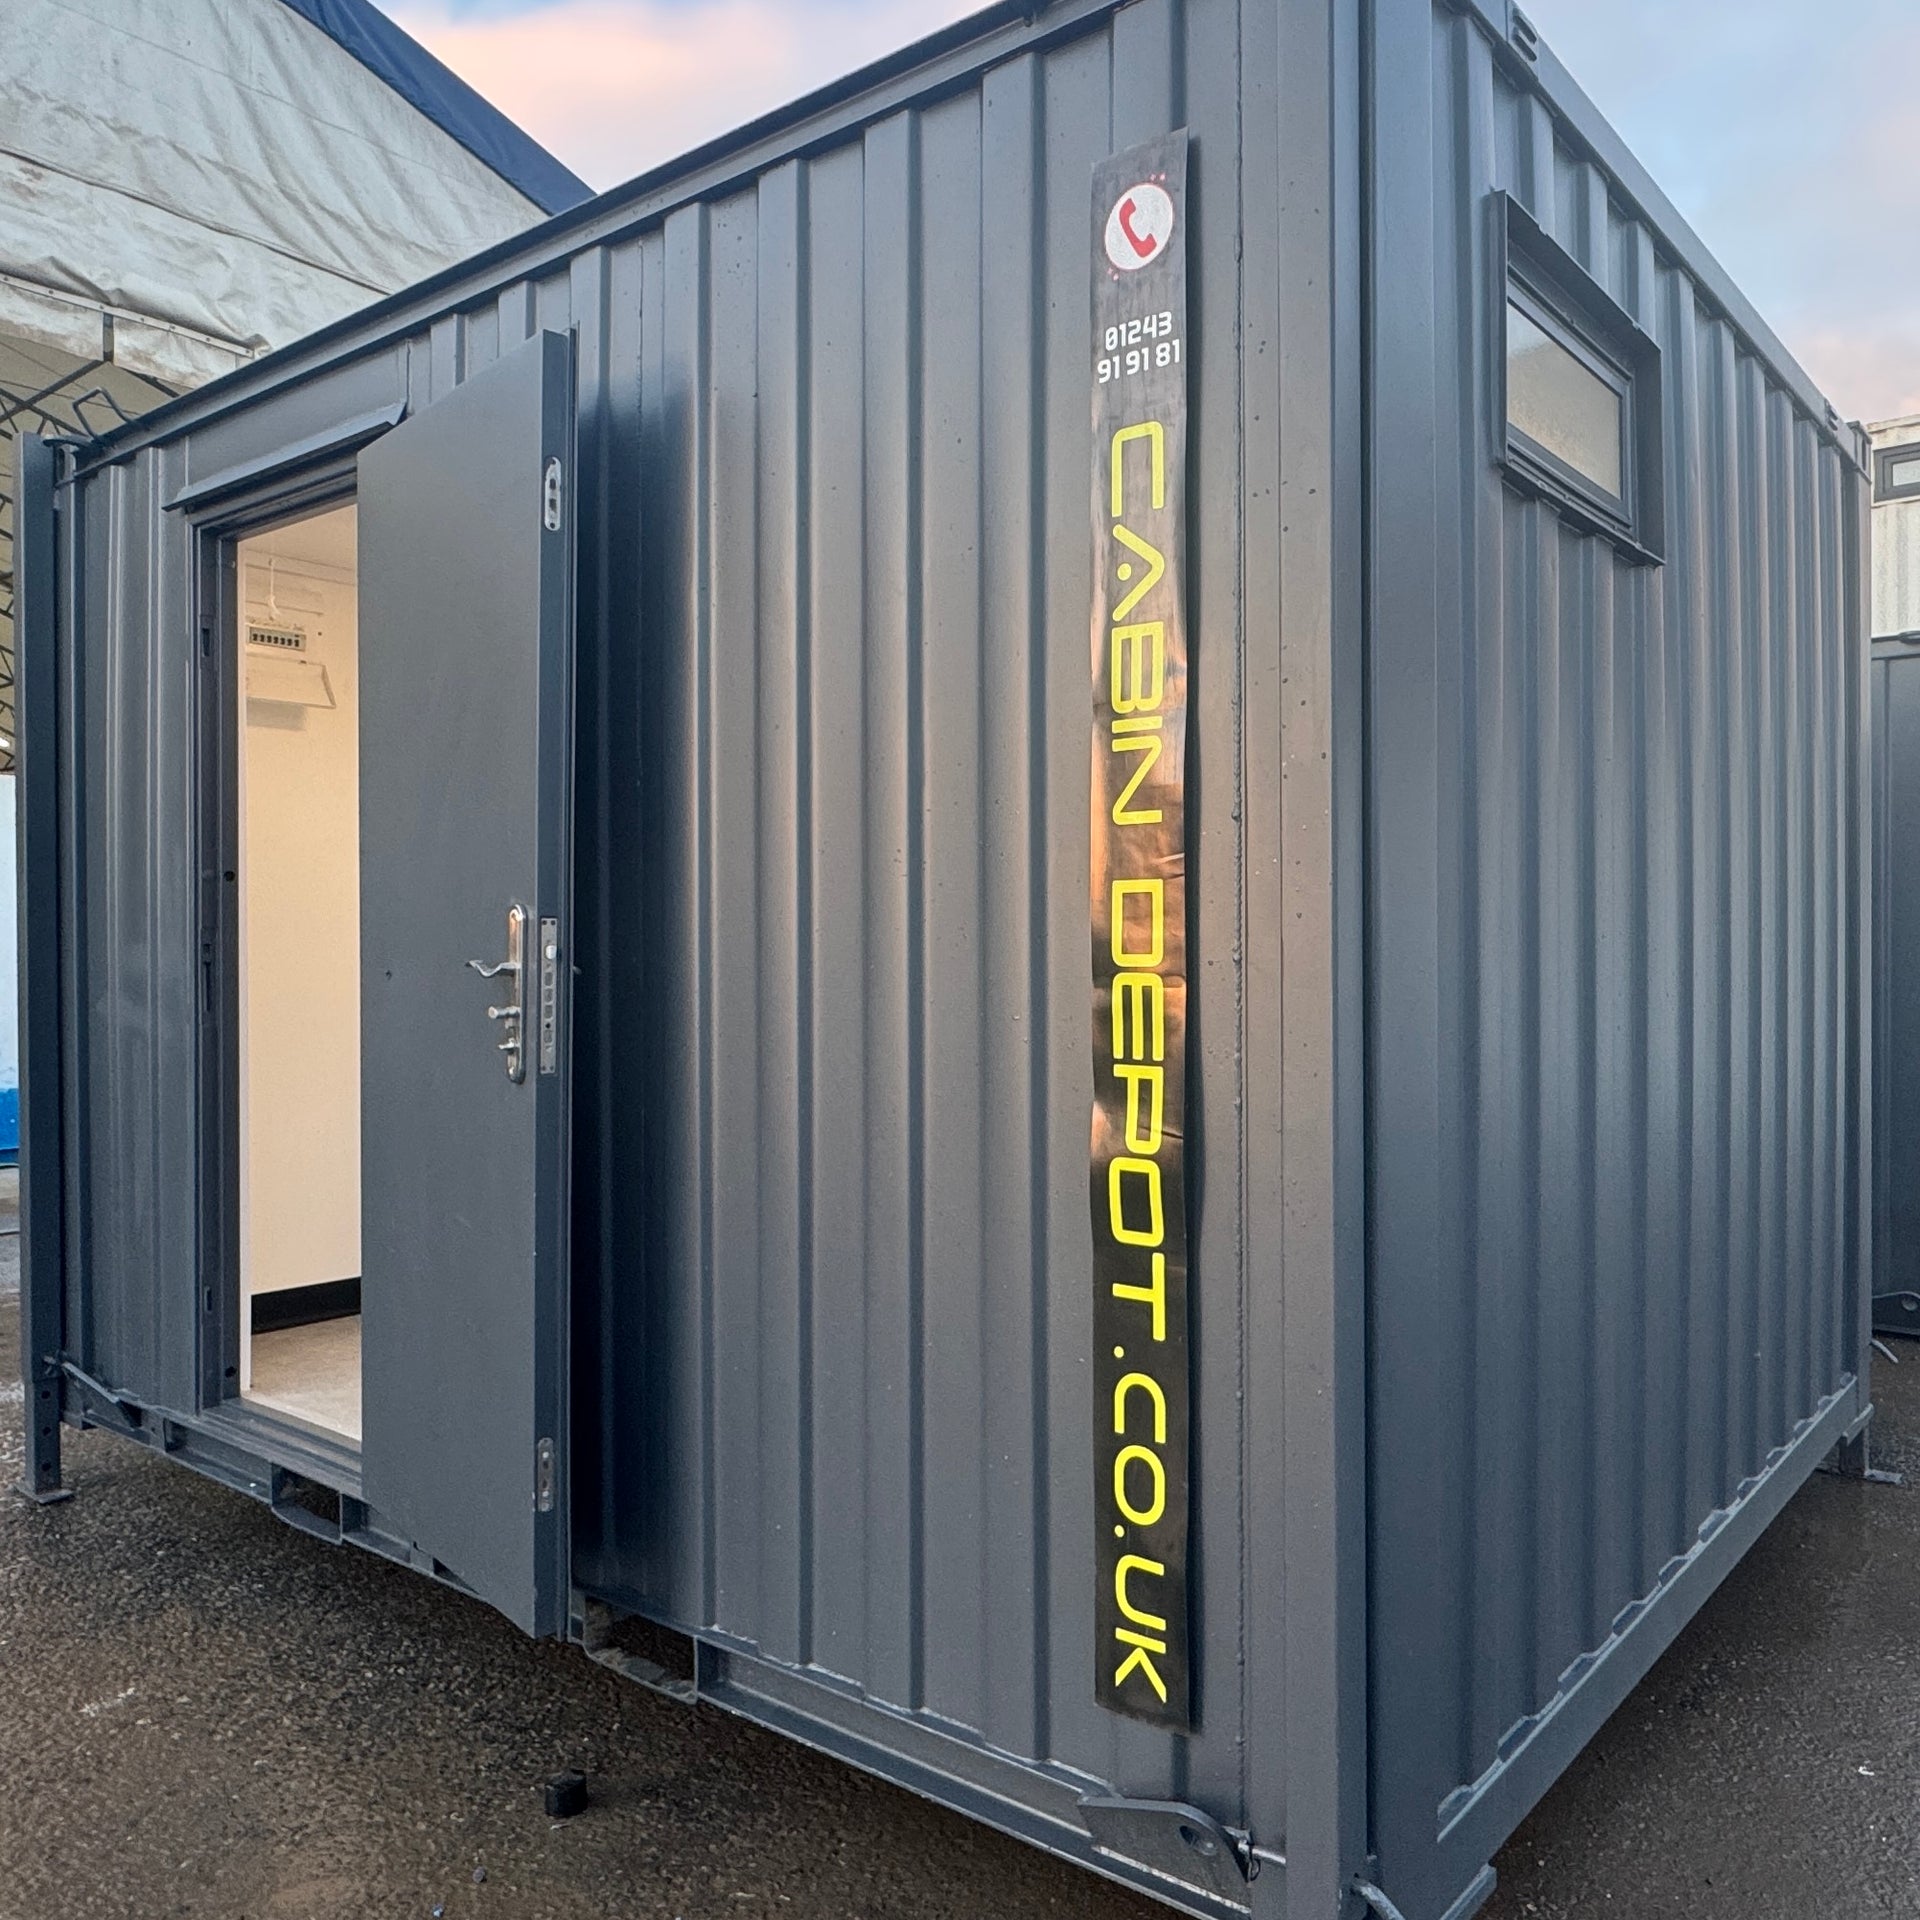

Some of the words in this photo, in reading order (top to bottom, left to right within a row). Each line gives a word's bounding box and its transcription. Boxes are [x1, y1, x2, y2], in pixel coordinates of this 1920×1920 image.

[1105, 311, 1172, 351] 01243
[1111, 421, 1164, 826] CABIN
[1109, 878, 1167, 1703] DEPOT.CO.UK
